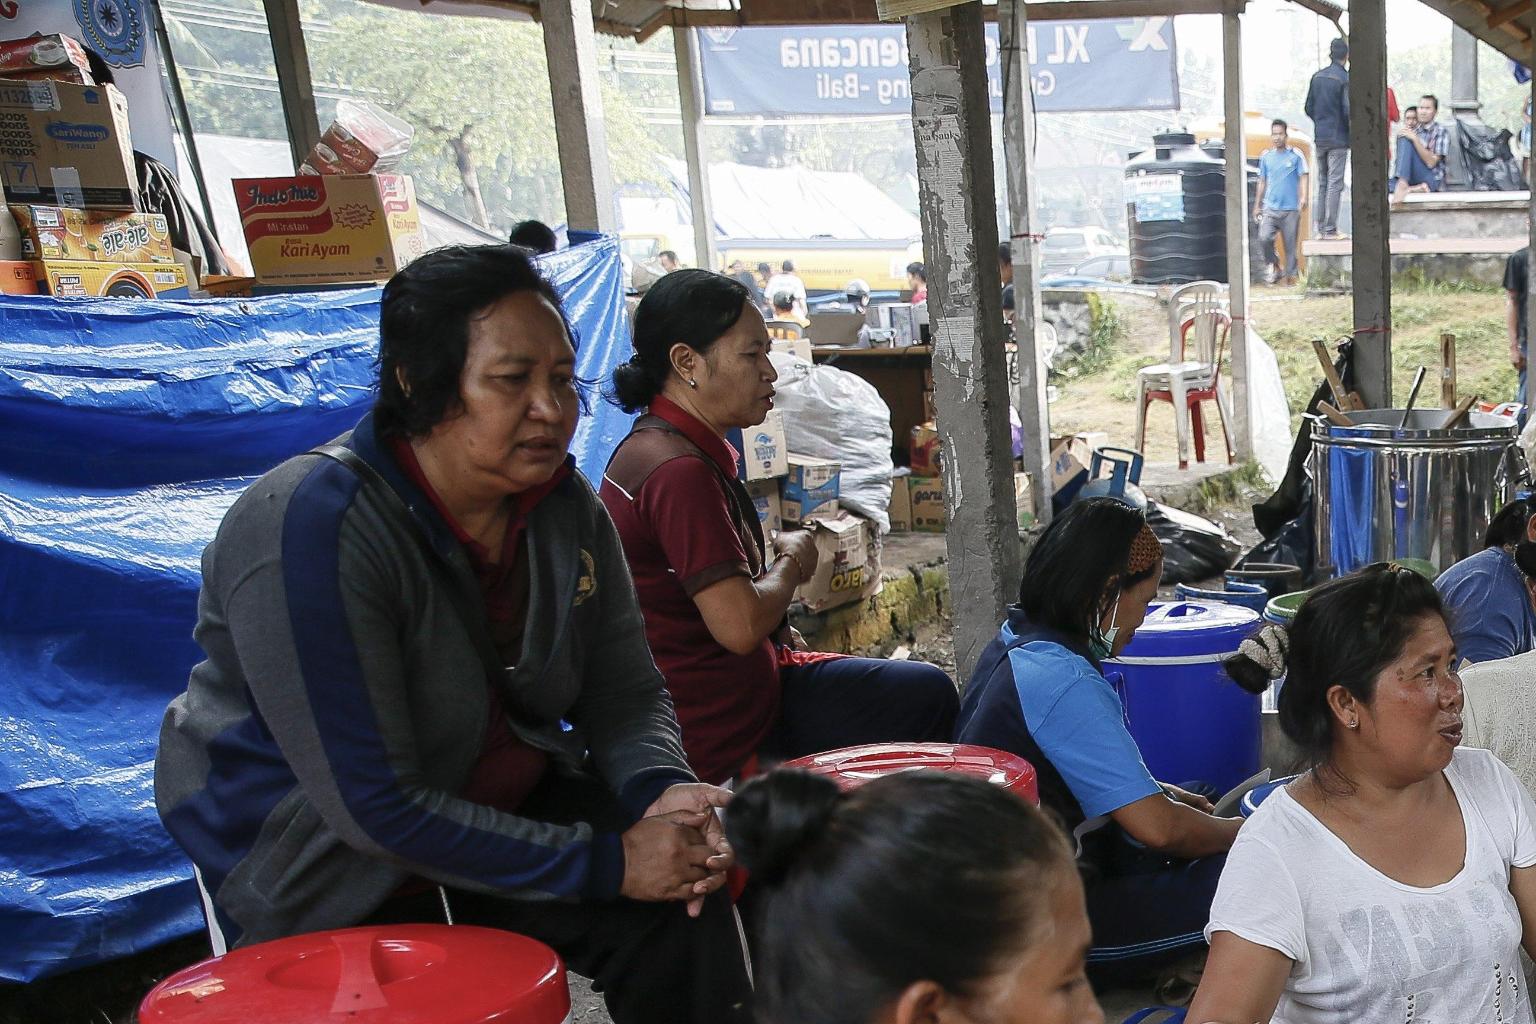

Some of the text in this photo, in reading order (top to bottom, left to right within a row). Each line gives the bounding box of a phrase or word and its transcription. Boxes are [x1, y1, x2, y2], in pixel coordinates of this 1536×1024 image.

[12, 164, 28, 183] 7
[280, 242, 350, 260] Kari Ayam
[913, 490, 943, 505] garu
